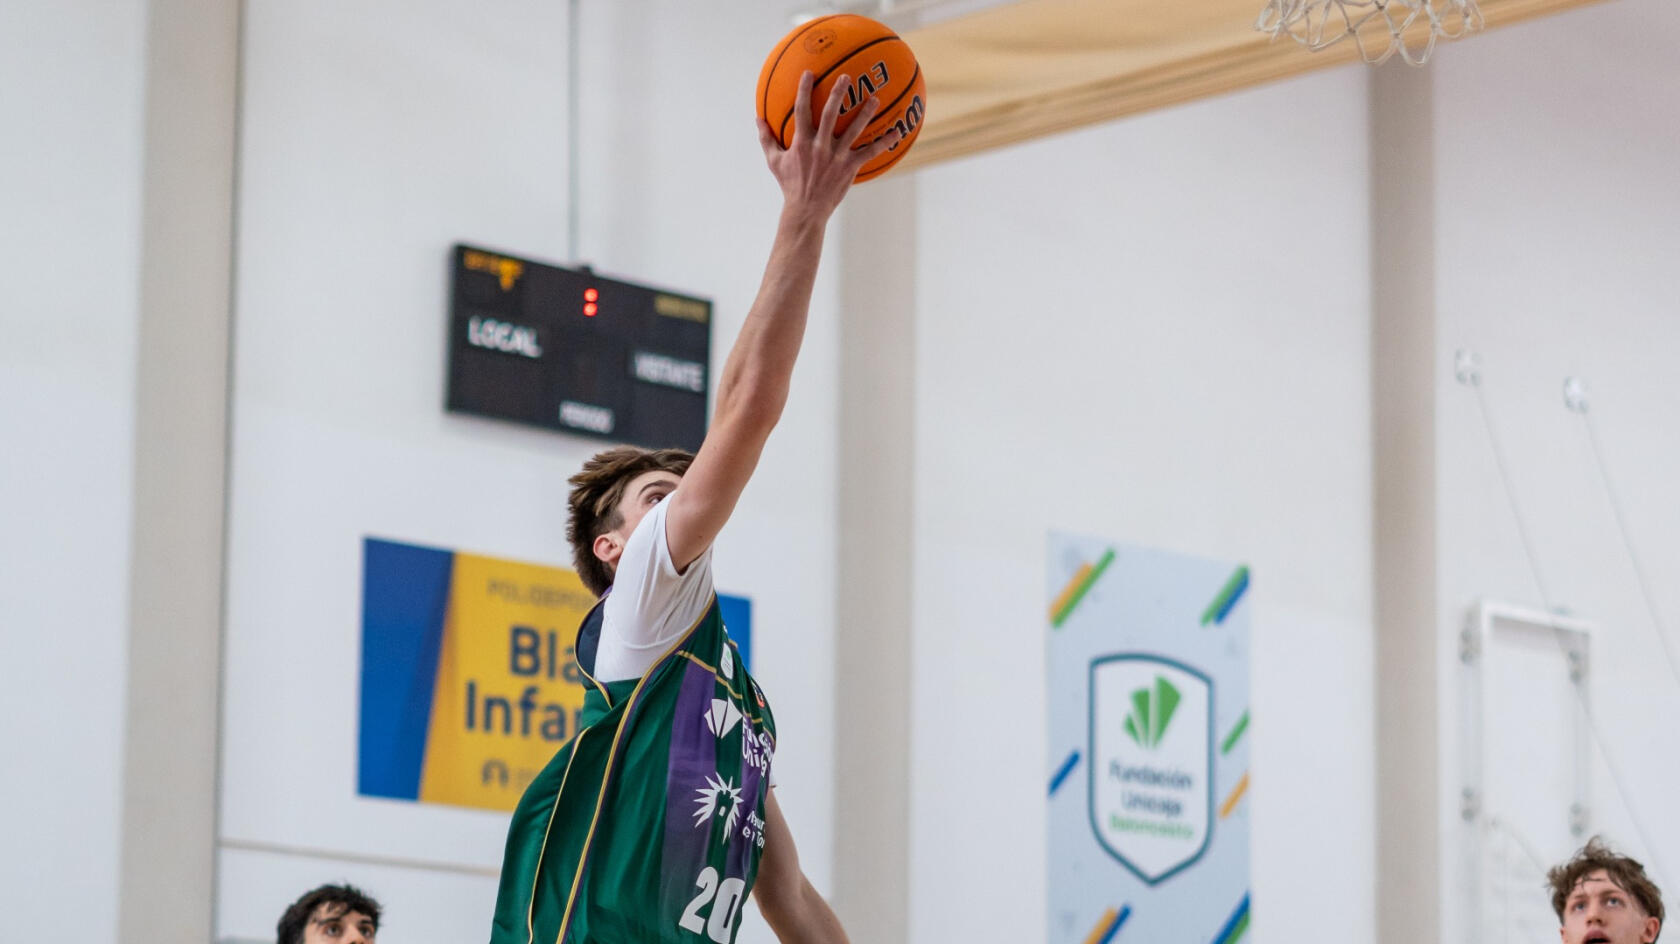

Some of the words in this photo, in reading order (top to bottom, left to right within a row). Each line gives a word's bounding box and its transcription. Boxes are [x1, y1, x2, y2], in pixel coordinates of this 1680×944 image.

[467, 315, 541, 358] LOCAL
[509, 624, 581, 683] Bla
[679, 866, 745, 944] 20
